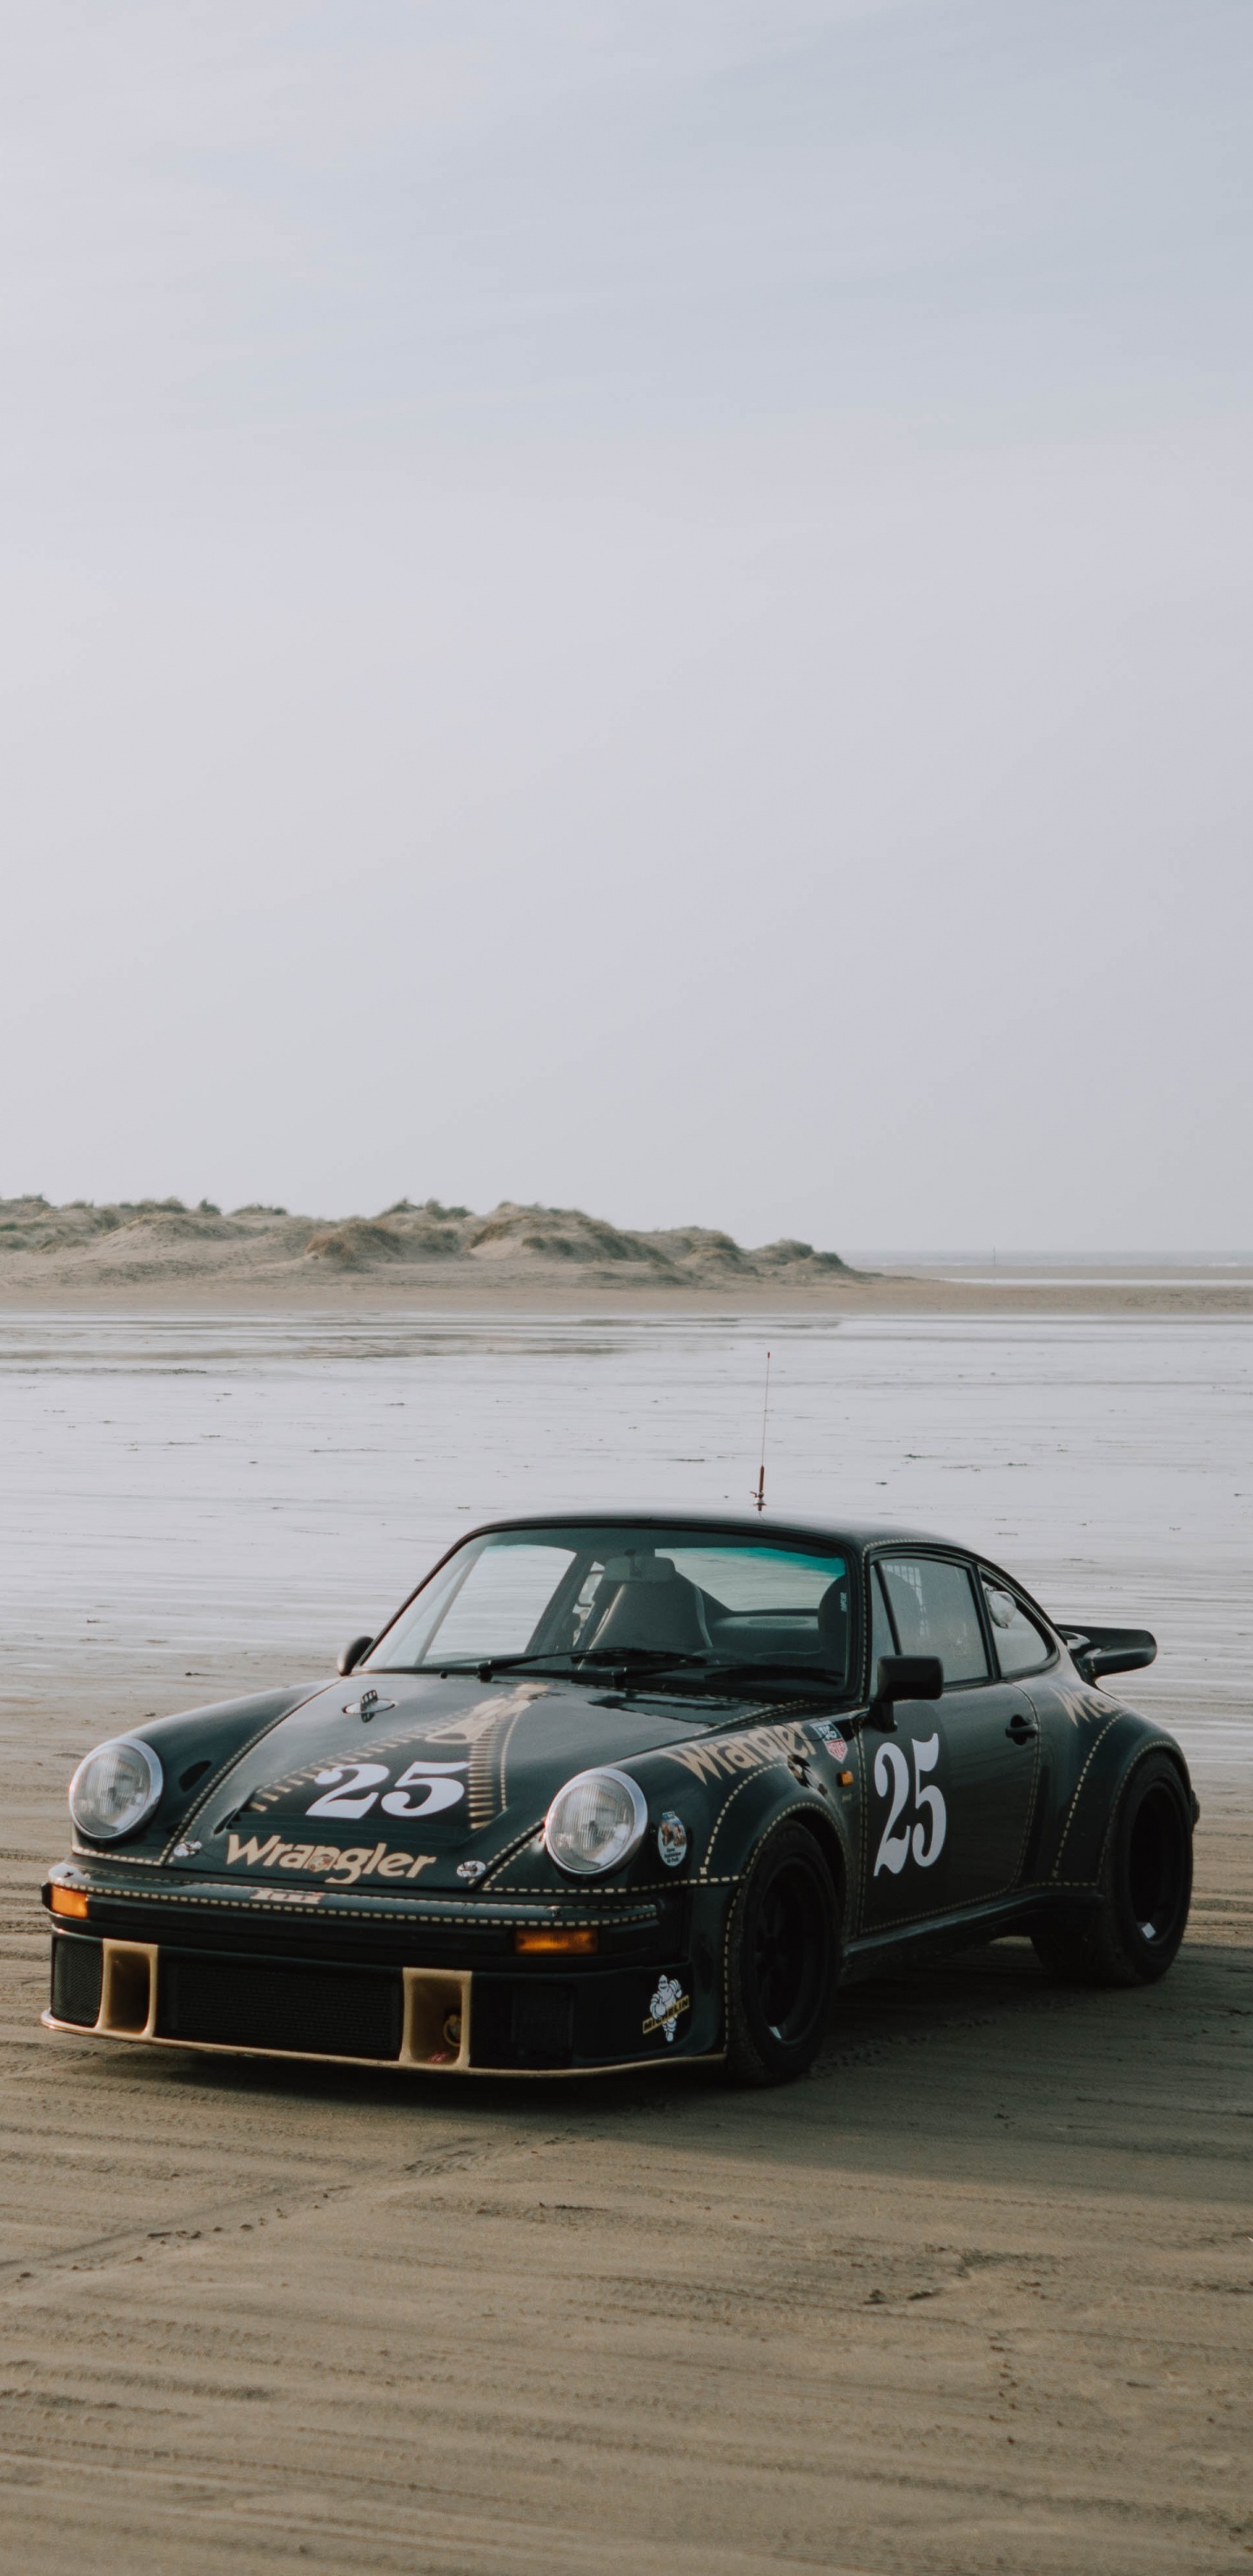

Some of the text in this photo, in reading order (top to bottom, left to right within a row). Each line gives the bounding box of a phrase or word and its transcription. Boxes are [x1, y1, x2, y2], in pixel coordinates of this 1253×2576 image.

[305, 1761, 473, 1819] 25
[874, 1733, 947, 1877] 25
[226, 1834, 437, 1884] Wrangler
